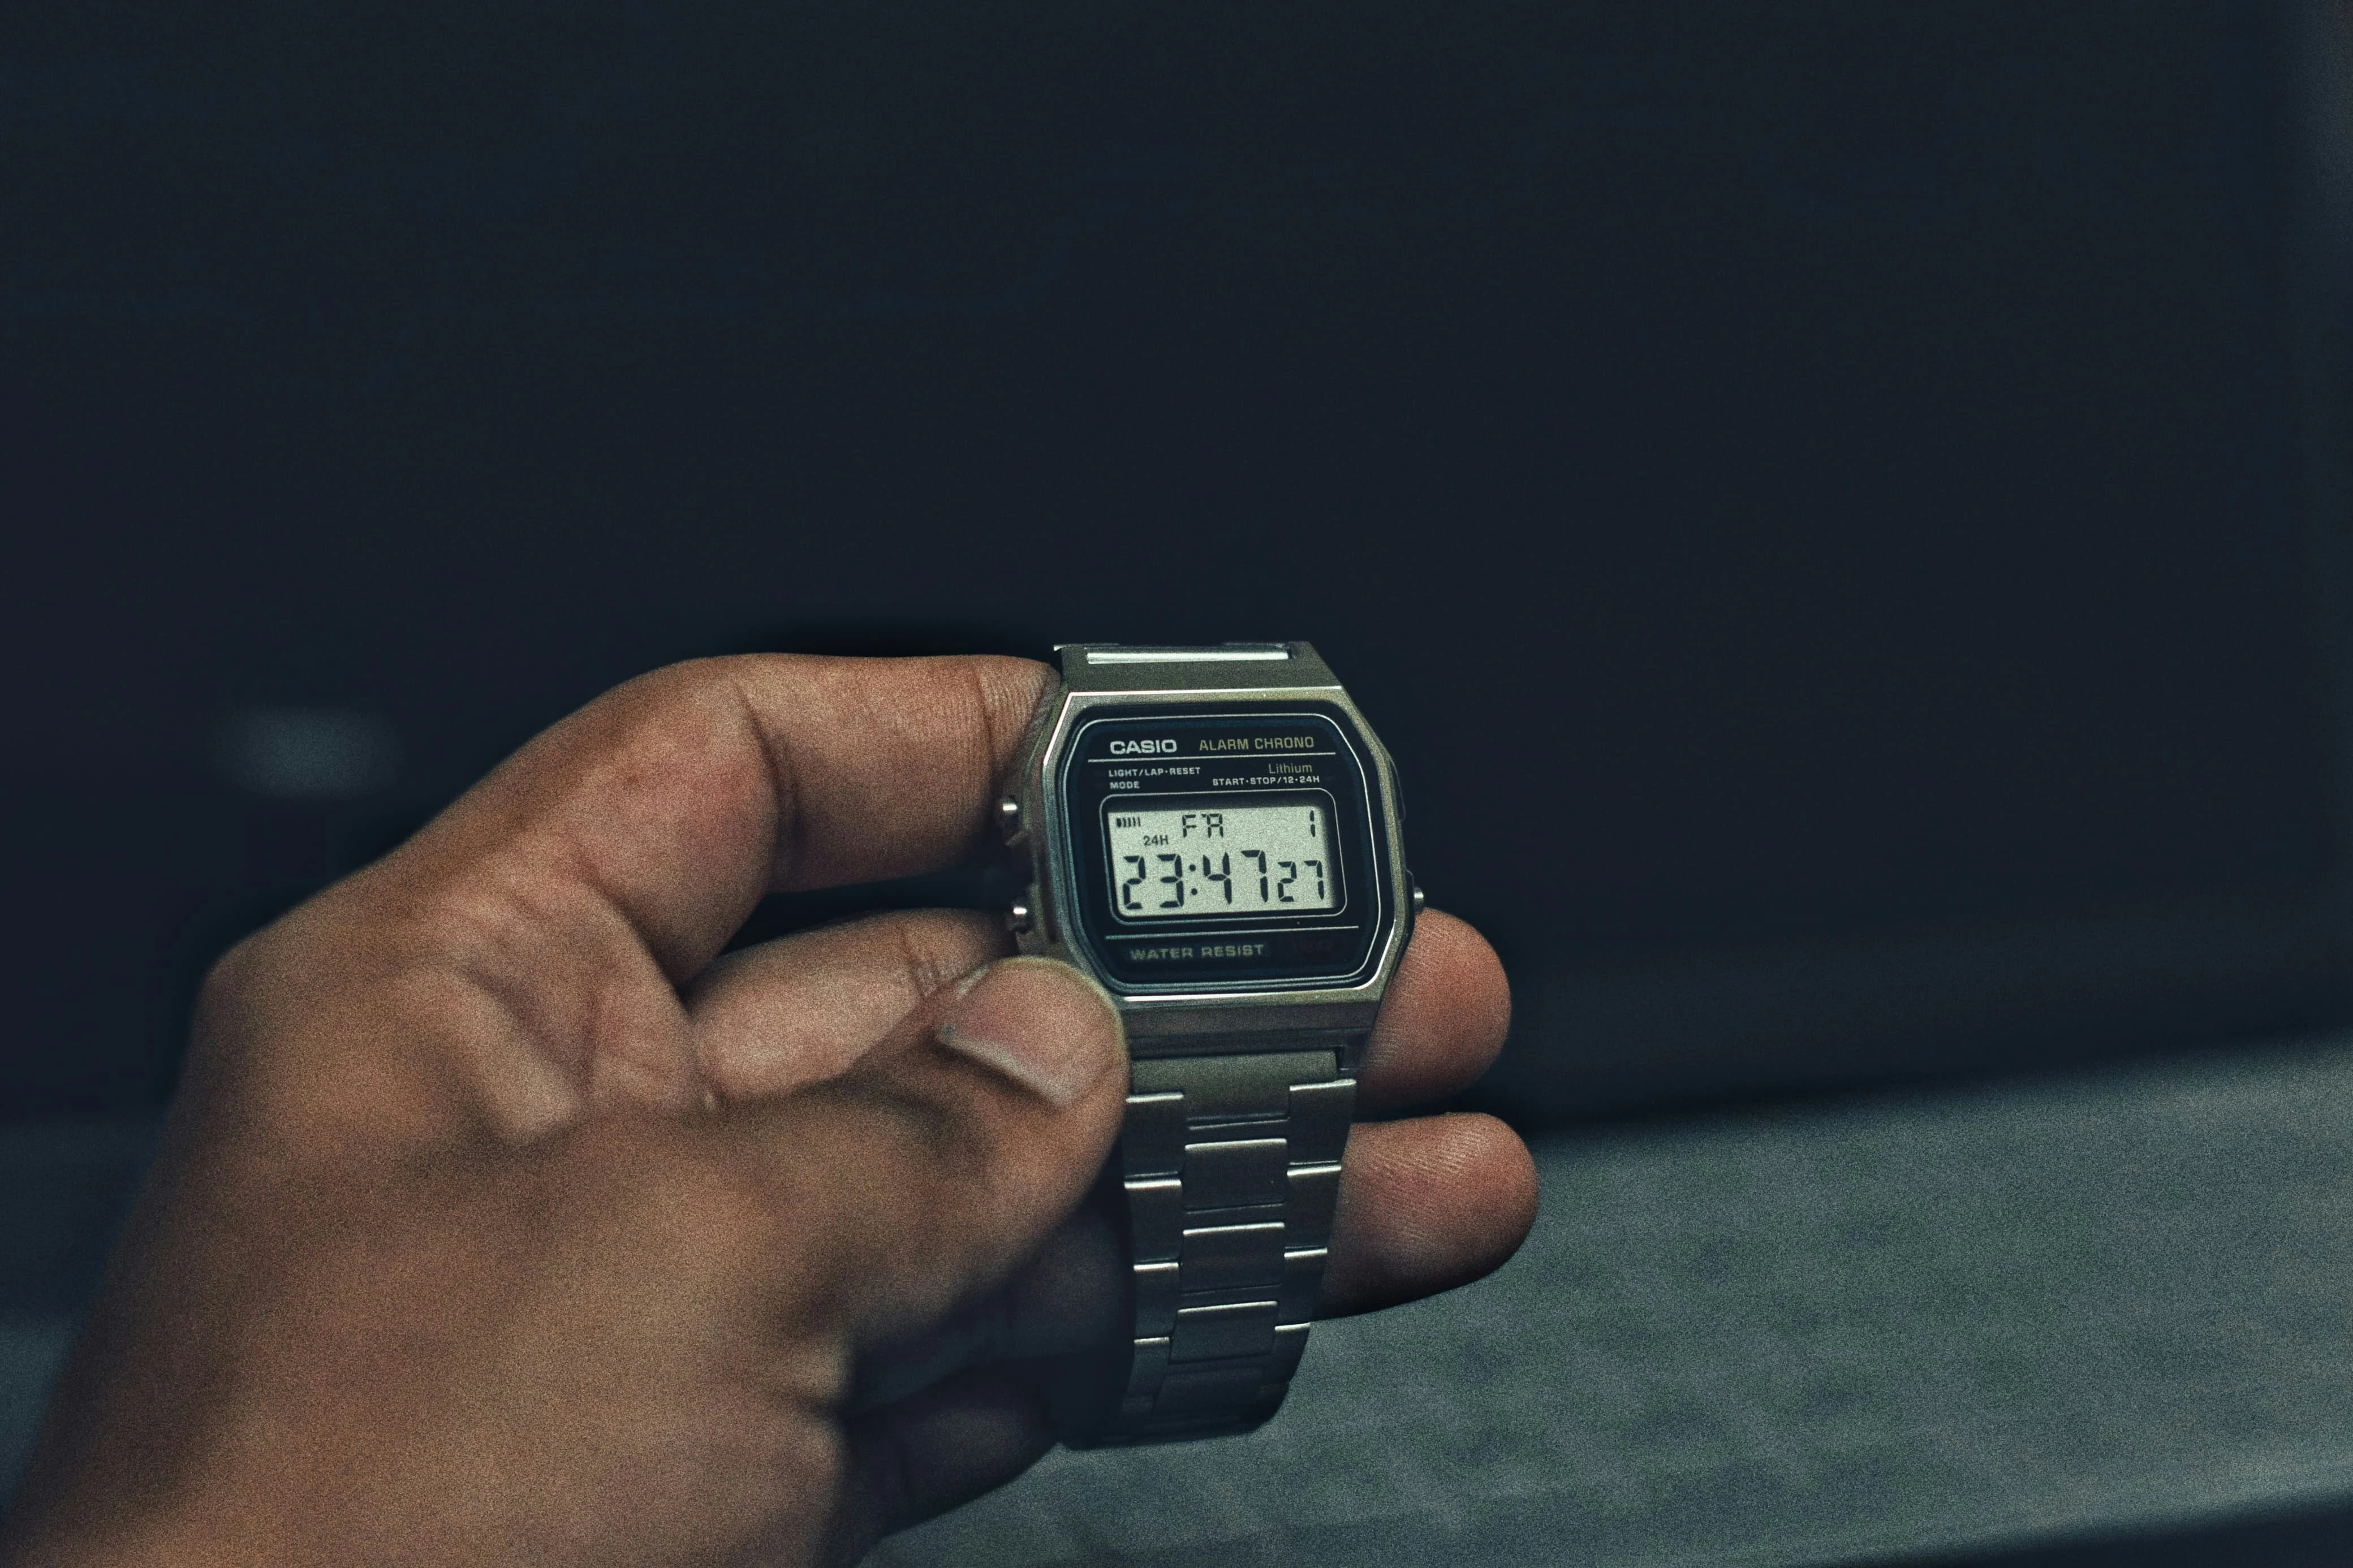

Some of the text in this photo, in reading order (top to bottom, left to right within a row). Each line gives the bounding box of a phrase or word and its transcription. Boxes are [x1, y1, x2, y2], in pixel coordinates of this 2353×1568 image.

[1110, 739, 1177, 754] CASIO
[1200, 737, 1314, 751] ALARM CHRONO
[1269, 763, 1312, 774] Lithium
[1309, 810, 1315, 837] 1
[1143, 835, 1169, 846] 24H
[1131, 944, 1265, 959] WATER RESIST
